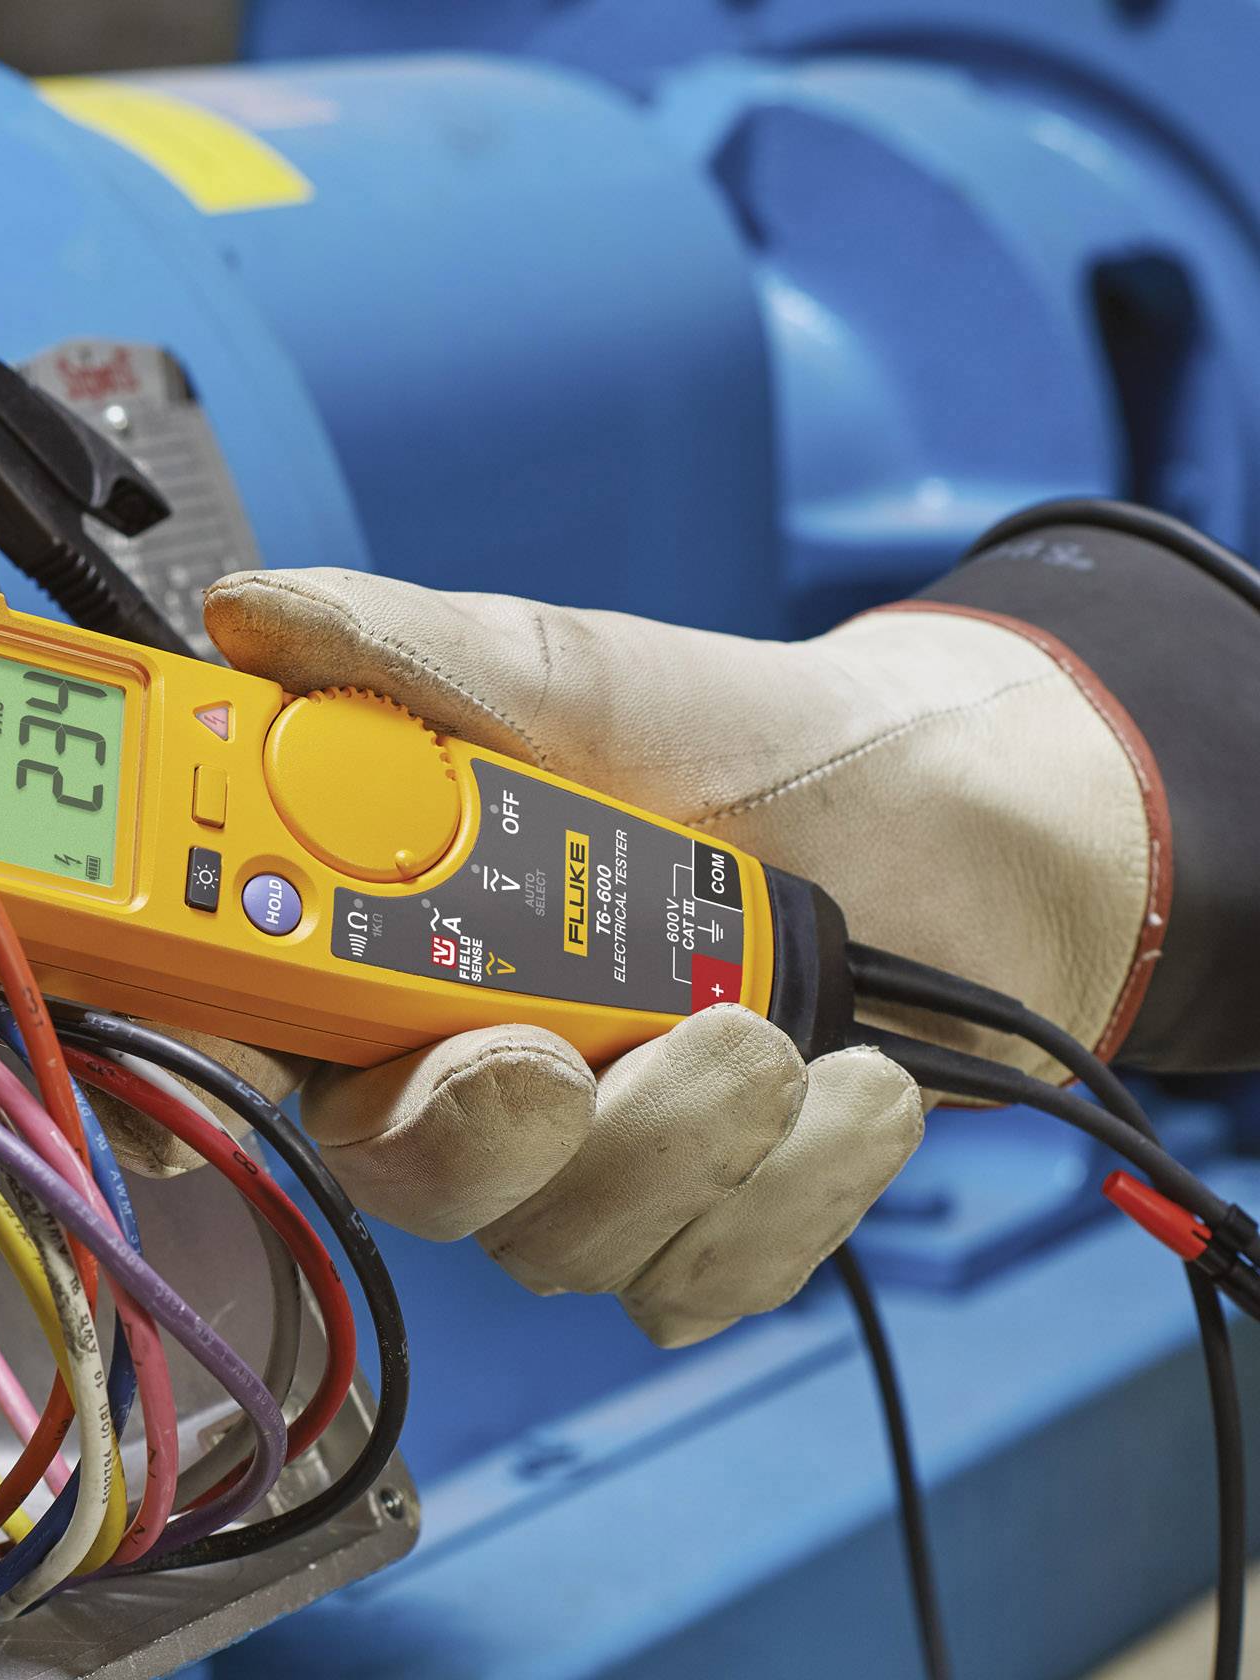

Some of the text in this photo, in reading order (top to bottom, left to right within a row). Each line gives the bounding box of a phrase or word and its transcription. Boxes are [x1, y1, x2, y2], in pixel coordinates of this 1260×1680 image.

[16, 671, 108, 812] 234
[502, 790, 519, 834] OFF
[525, 873, 535, 907] AUTO
[535, 868, 546, 917] SELECT
[569, 842, 586, 945] FLUKE
[711, 853, 725, 894] COM
[266, 879, 283, 925] HOLD
[596, 865, 612, 935] T6-600
[614, 829, 628, 983] ELECTRICAL TESTER
[683, 918, 695, 950] CAT
[459, 935, 471, 980] FIELD
[471, 938, 483, 983] SENSE
[233, 1149, 259, 1176] 8
[110, 1170, 132, 1215] AWM
[350, 1211, 369, 1241] 5
[81, 1312, 98, 1354] AWG
[94, 1369, 106, 1389] 10
